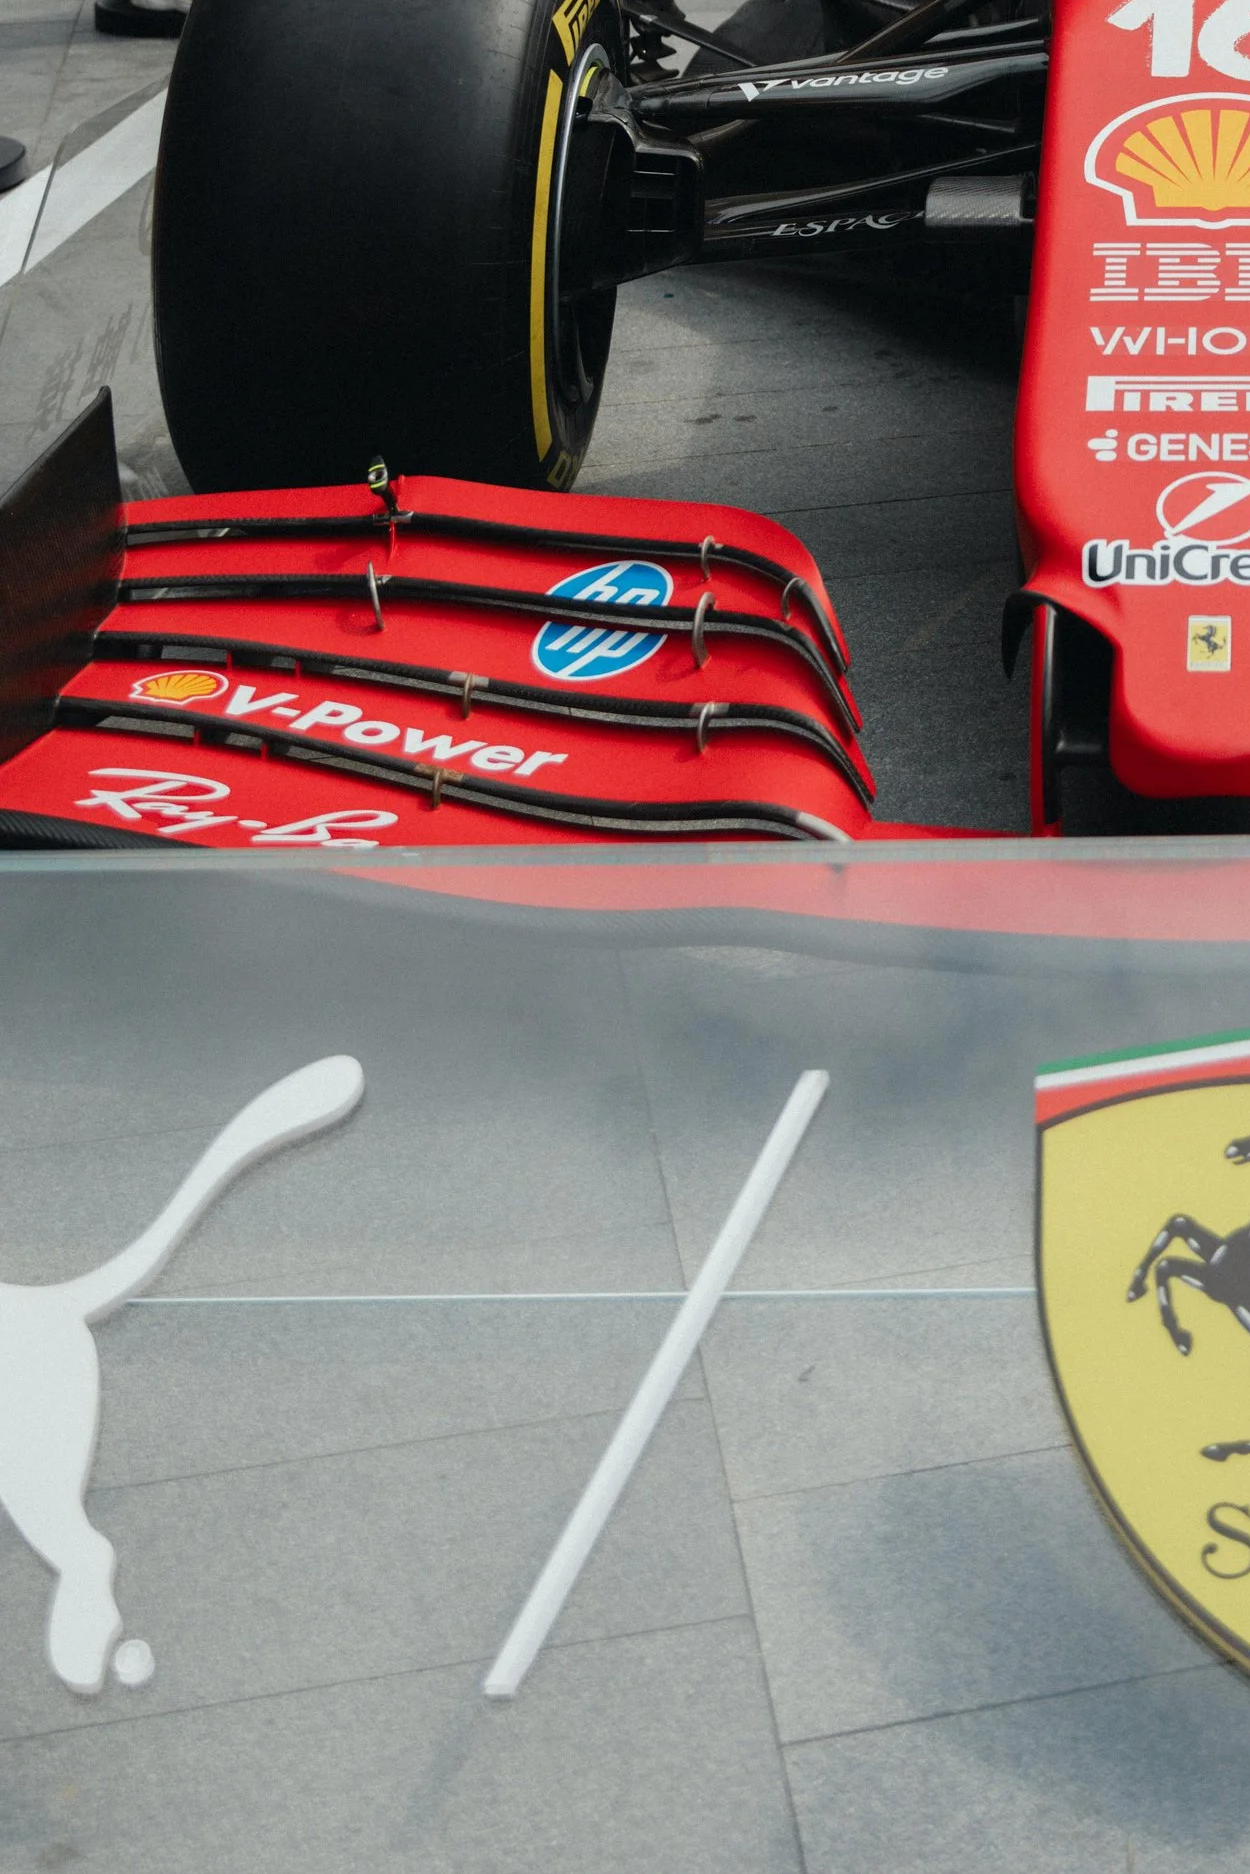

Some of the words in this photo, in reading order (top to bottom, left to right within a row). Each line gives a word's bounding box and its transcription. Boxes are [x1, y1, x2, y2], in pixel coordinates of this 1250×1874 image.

[790, 66, 949, 90] vantage
[544, 561, 661, 678] hp
[224, 684, 569, 777] V-Power
